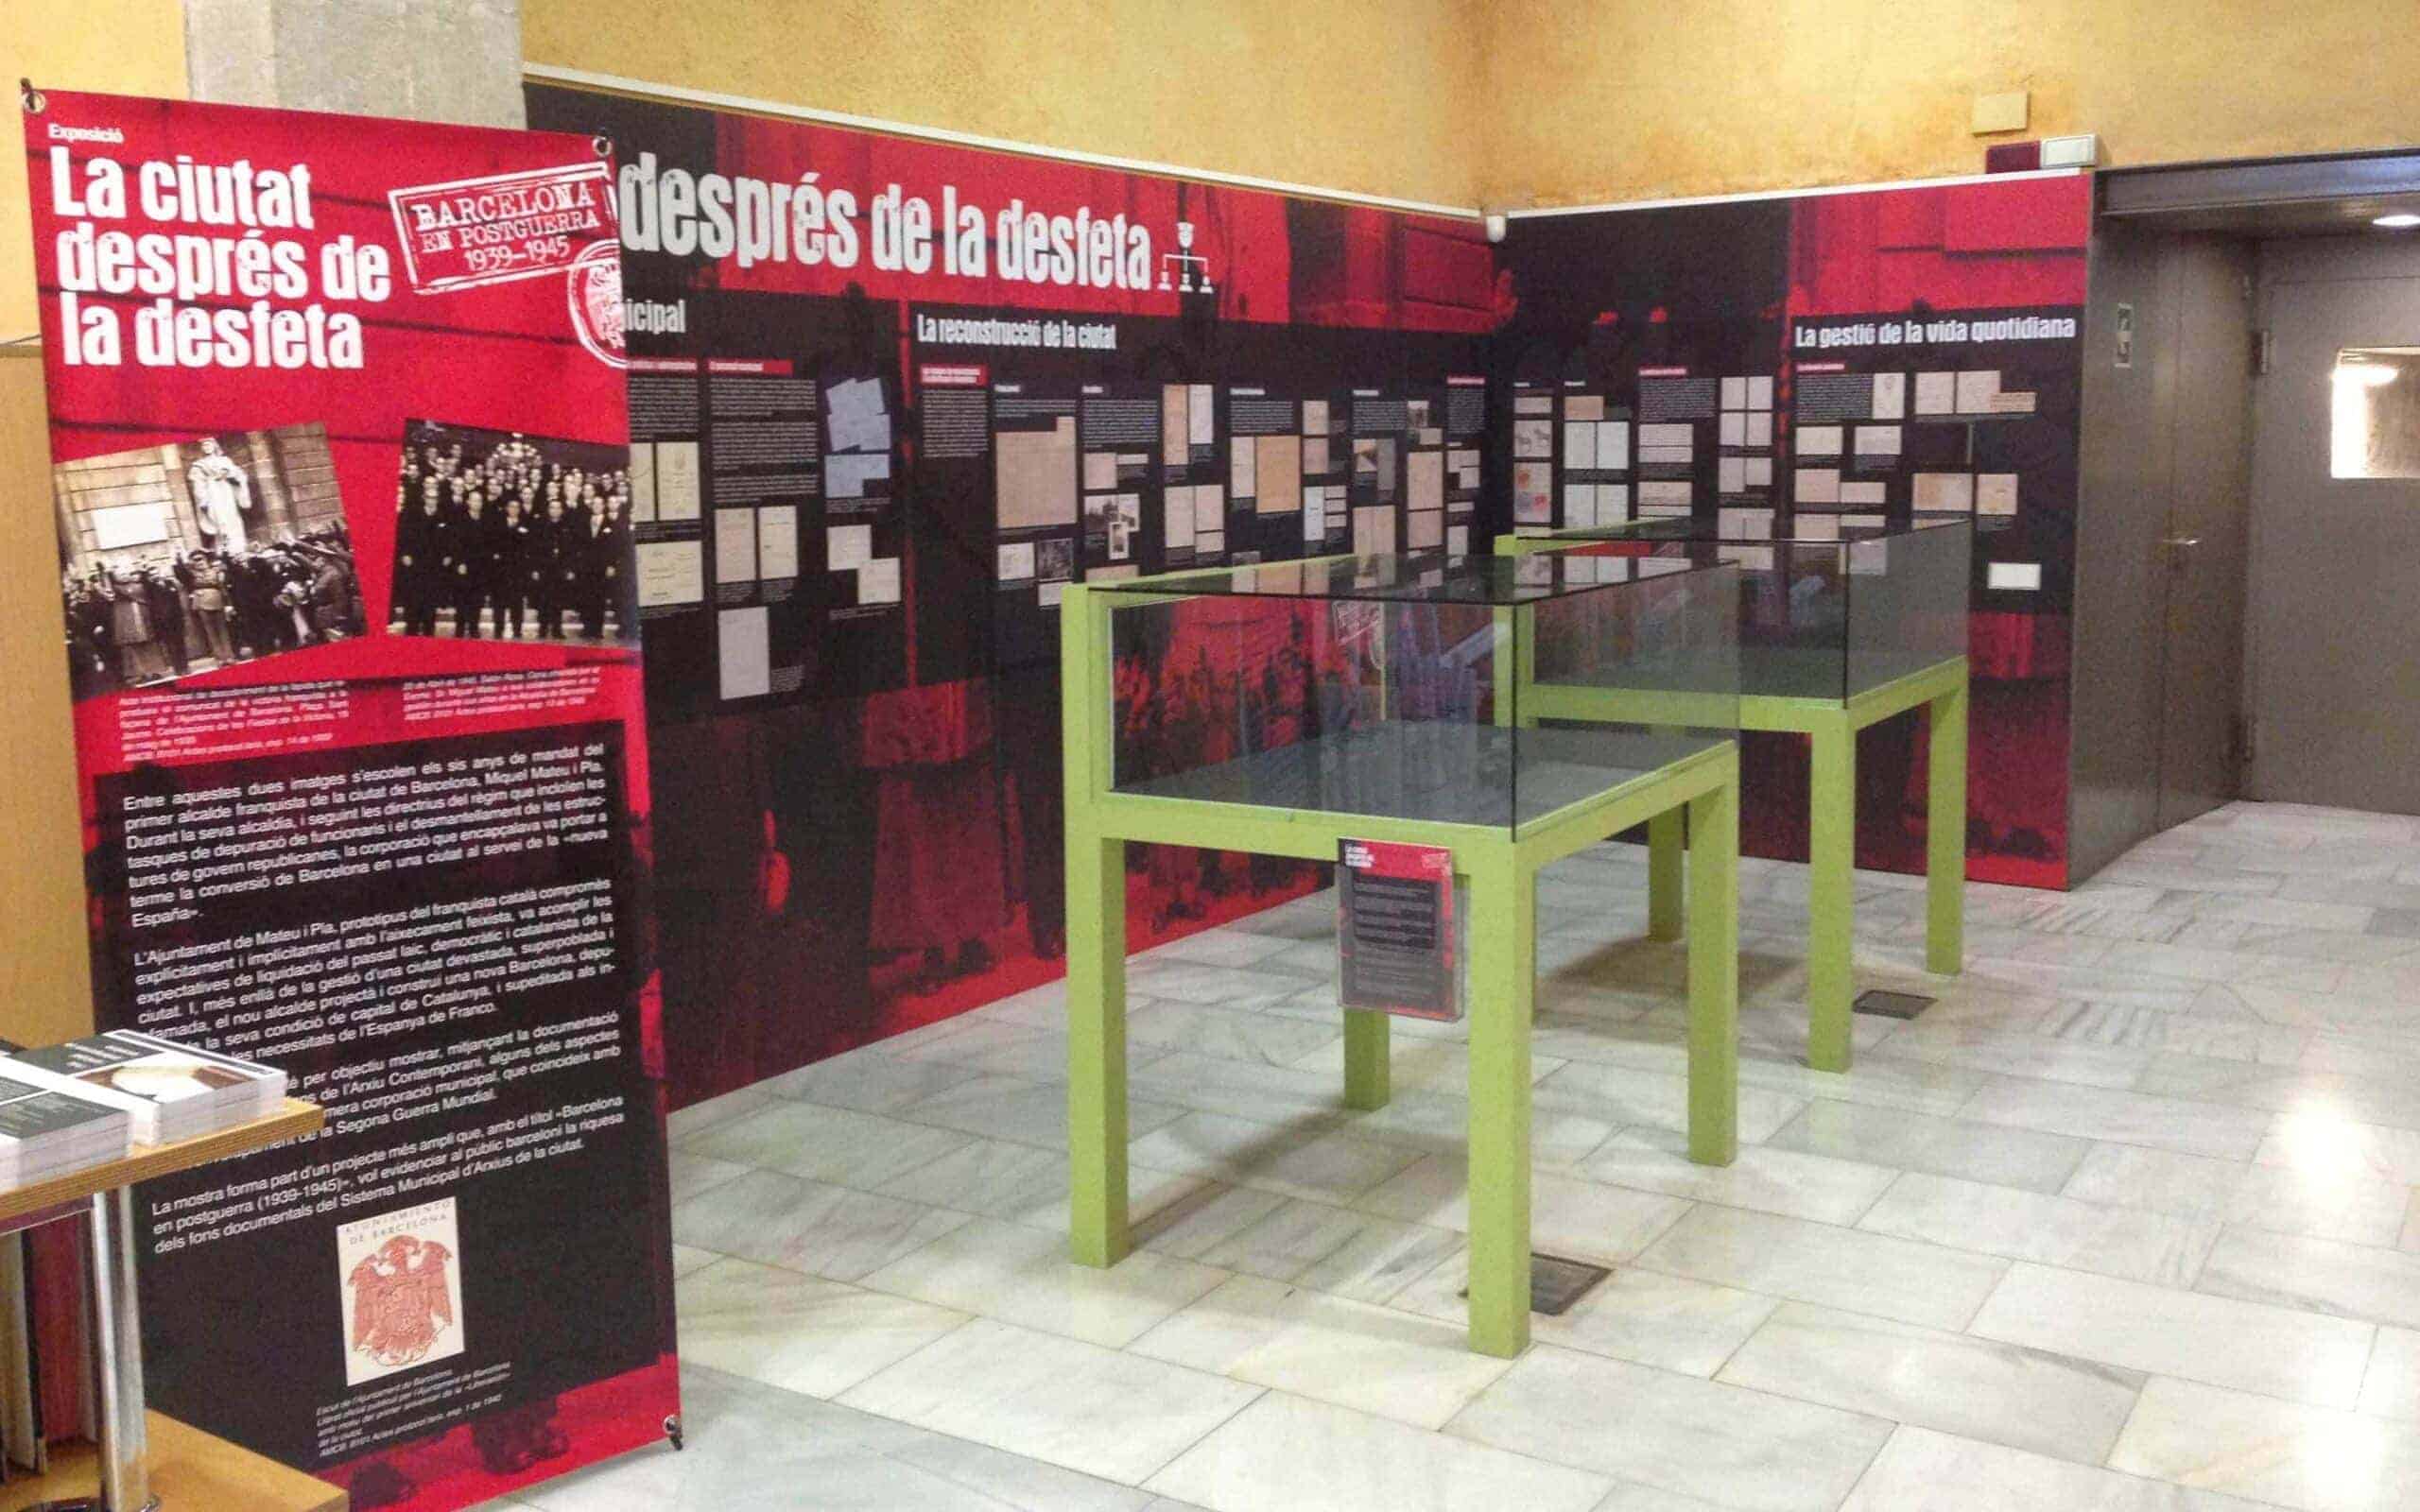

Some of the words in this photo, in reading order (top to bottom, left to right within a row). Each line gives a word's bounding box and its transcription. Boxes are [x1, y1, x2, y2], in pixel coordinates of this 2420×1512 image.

[48, 122, 125, 143] Exposició
[51, 146, 127, 219] La
[140, 155, 315, 230] ciutat
[410, 181, 596, 232] BARCELONA
[420, 230, 454, 253] EN
[460, 209, 600, 248] POSTGUERRA
[619, 153, 857, 267] després
[871, 183, 931, 274] de
[944, 187, 985, 279] la
[997, 199, 1151, 290] desfeta
[57, 221, 309, 301] després
[320, 234, 392, 302] de
[60, 291, 122, 366] la
[135, 298, 365, 369] desfeta
[623, 299, 686, 335] icipal
[918, 314, 937, 343] La
[939, 318, 1041, 347] reconstrucció
[1043, 321, 1061, 348] de
[1063, 319, 1075, 348] la
[1796, 327, 1815, 348] La
[1818, 324, 1876, 348] gestió
[1879, 322, 1902, 344] de
[1906, 320, 1923, 343] la
[1926, 320, 1968, 342] vida
[1971, 318, 2076, 342] quotidiana
[234, 936, 252, 949] de
[256, 929, 300, 945] Mateu
[340, 912, 406, 934] prototipus
[410, 905, 429, 919] del
[433, 897, 495, 916] franquista
[234, 973, 251, 987] de
[327, 955, 347, 970] del
[353, 947, 396, 969] passat
[582, 914, 597, 926] de
[601, 912, 612, 922] la
[346, 932, 375, 948] amb
[539, 899, 588, 916] acomplir
[594, 896, 611, 907] les
[216, 1014, 228, 1028] el
[233, 1011, 260, 1024] nou
[266, 999, 315, 1019] alcalde
[445, 972, 470, 985] una
[475, 966, 505, 979] nova
[279, 984, 297, 997] de
[302, 981, 314, 993] la
[406, 957, 441, 973] ciutat
[202, 1037, 218, 1049] la
[226, 1030, 259, 1044] seva
[328, 1012, 345, 1024] de
[352, 1001, 395, 1021] capital
[400, 999, 417, 1011] de
[506, 970, 572, 991] supeditada
[578, 965, 595, 977] als
[338, 1028, 355, 1041] de
[429, 1011, 444, 1023] de
[304, 1073, 326, 1089] per
[332, 1060, 384, 1079] objectiu
[517, 1030, 528, 1040] la
[320, 1087, 337, 1100] de
[490, 1048, 530, 1065] alguns
[535, 1040, 561, 1055] dels
[565, 1030, 618, 1049] aspectes
[504, 1066, 527, 1082] que
[530, 1052, 589, 1073] coincideix
[594, 1043, 620, 1059] amb
[337, 1114, 389, 1133] Segona
[393, 1103, 438, 1121] Guerra
[153, 1201, 170, 1215] La
[175, 1190, 223, 1210] mostra
[227, 1179, 267, 1197] forma
[271, 1170, 297, 1190] part
[333, 1151, 385, 1175] projecte
[420, 1133, 453, 1151] ampli
[488, 1118, 514, 1135] amb
[518, 1115, 527, 1128] el
[154, 1222, 172, 1234] en
[177, 1201, 252, 1232] postguerra
[358, 1168, 377, 1183] vol
[381, 1155, 446, 1178] evidenciar
[451, 1148, 461, 1161] al
[566, 1123, 576, 1134] la
[580, 1113, 623, 1132] riquesa
[155, 1236, 184, 1253] dels
[189, 1228, 218, 1245] fons
[317, 1196, 337, 1212] del
[341, 1185, 394, 1206] Sistema
[399, 1167, 458, 1192] Municipal
[515, 1151, 530, 1163] de
[534, 1147, 544, 1159] la
